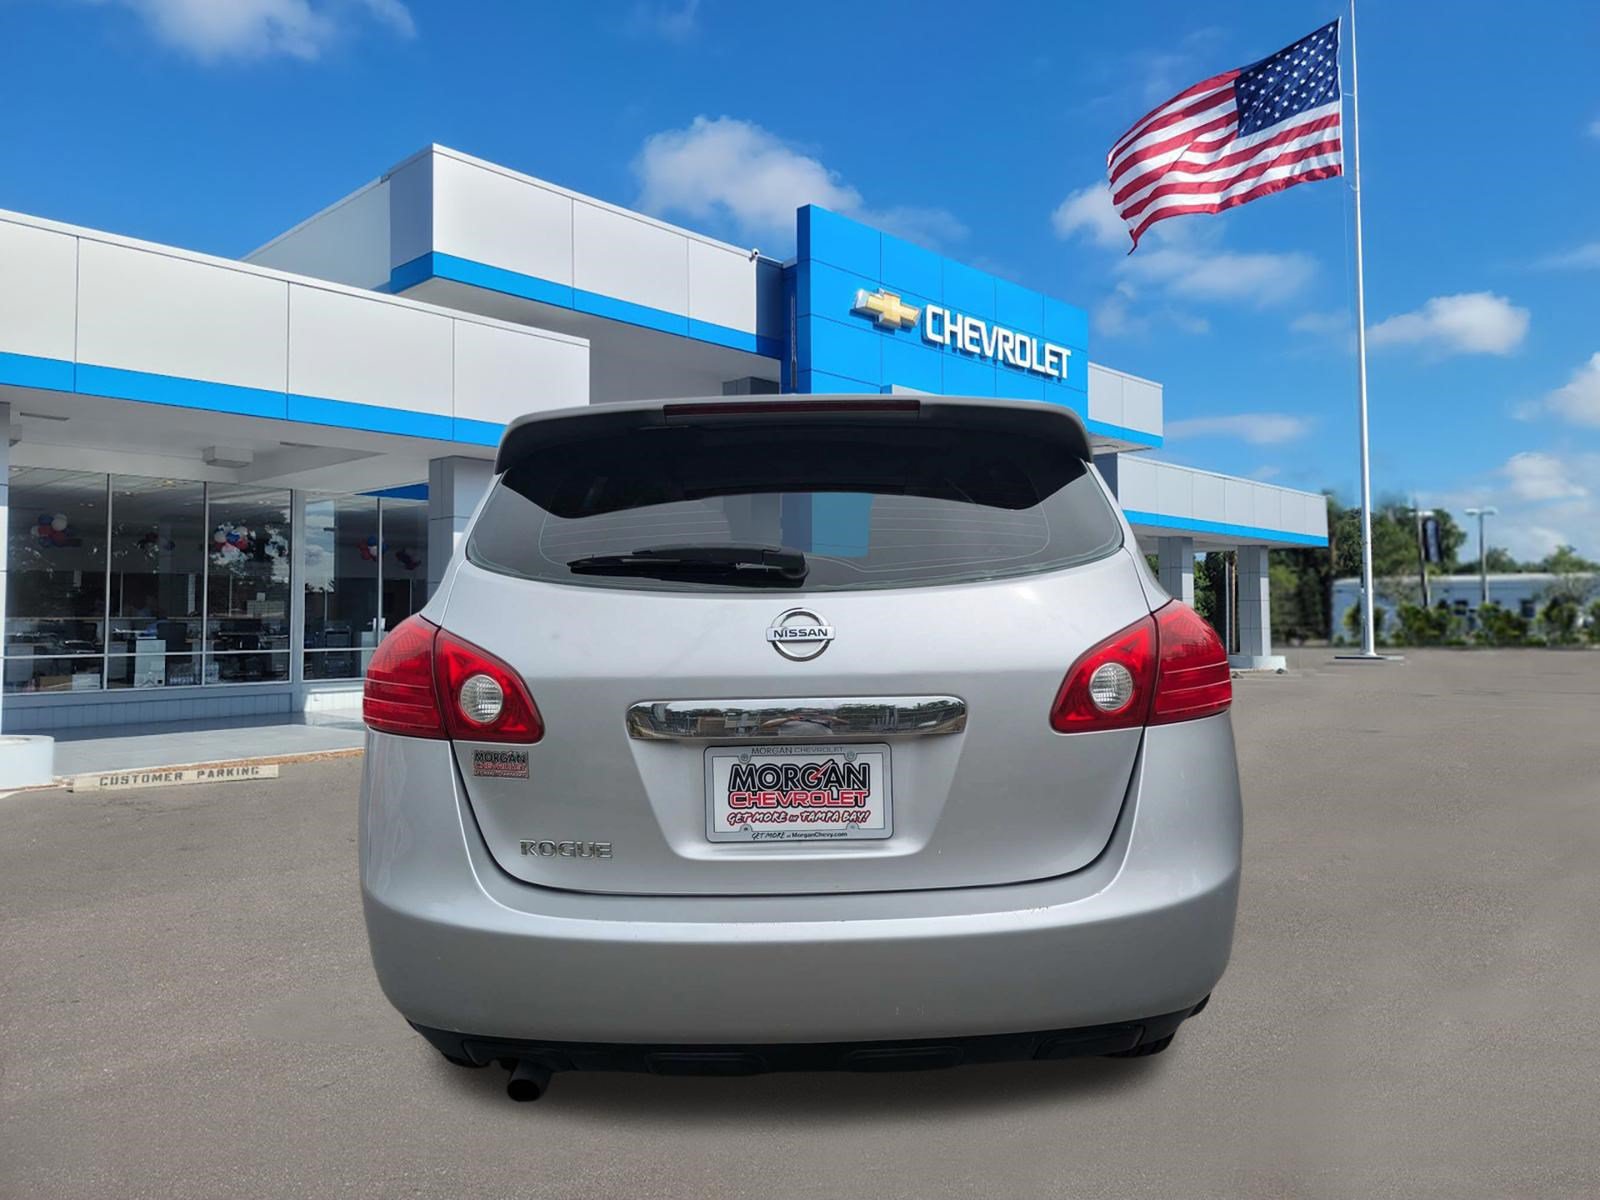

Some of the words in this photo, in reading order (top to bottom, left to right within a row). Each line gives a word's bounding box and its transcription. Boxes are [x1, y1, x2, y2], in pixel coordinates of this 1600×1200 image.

[924, 303, 1073, 379] CHEVROLET
[773, 628, 828, 638] NISSAN
[474, 751, 526, 763] MORGAN
[751, 746, 793, 755] MORGAN
[99, 772, 183, 786] CUSTOMER
[197, 766, 260, 779] PARKING
[729, 762, 870, 792] MORGAN
[729, 790, 870, 808] CHEVROLET
[727, 812, 753, 826] GET
[751, 811, 788, 823] MORE
[800, 810, 840, 823] TAMPA
[841, 810, 871, 824] BAY!
[752, 832, 767, 840] GET
[765, 831, 785, 839] MORE
[791, 831, 848, 839] MorganChevy.com
[519, 839, 613, 858] ROGUE
